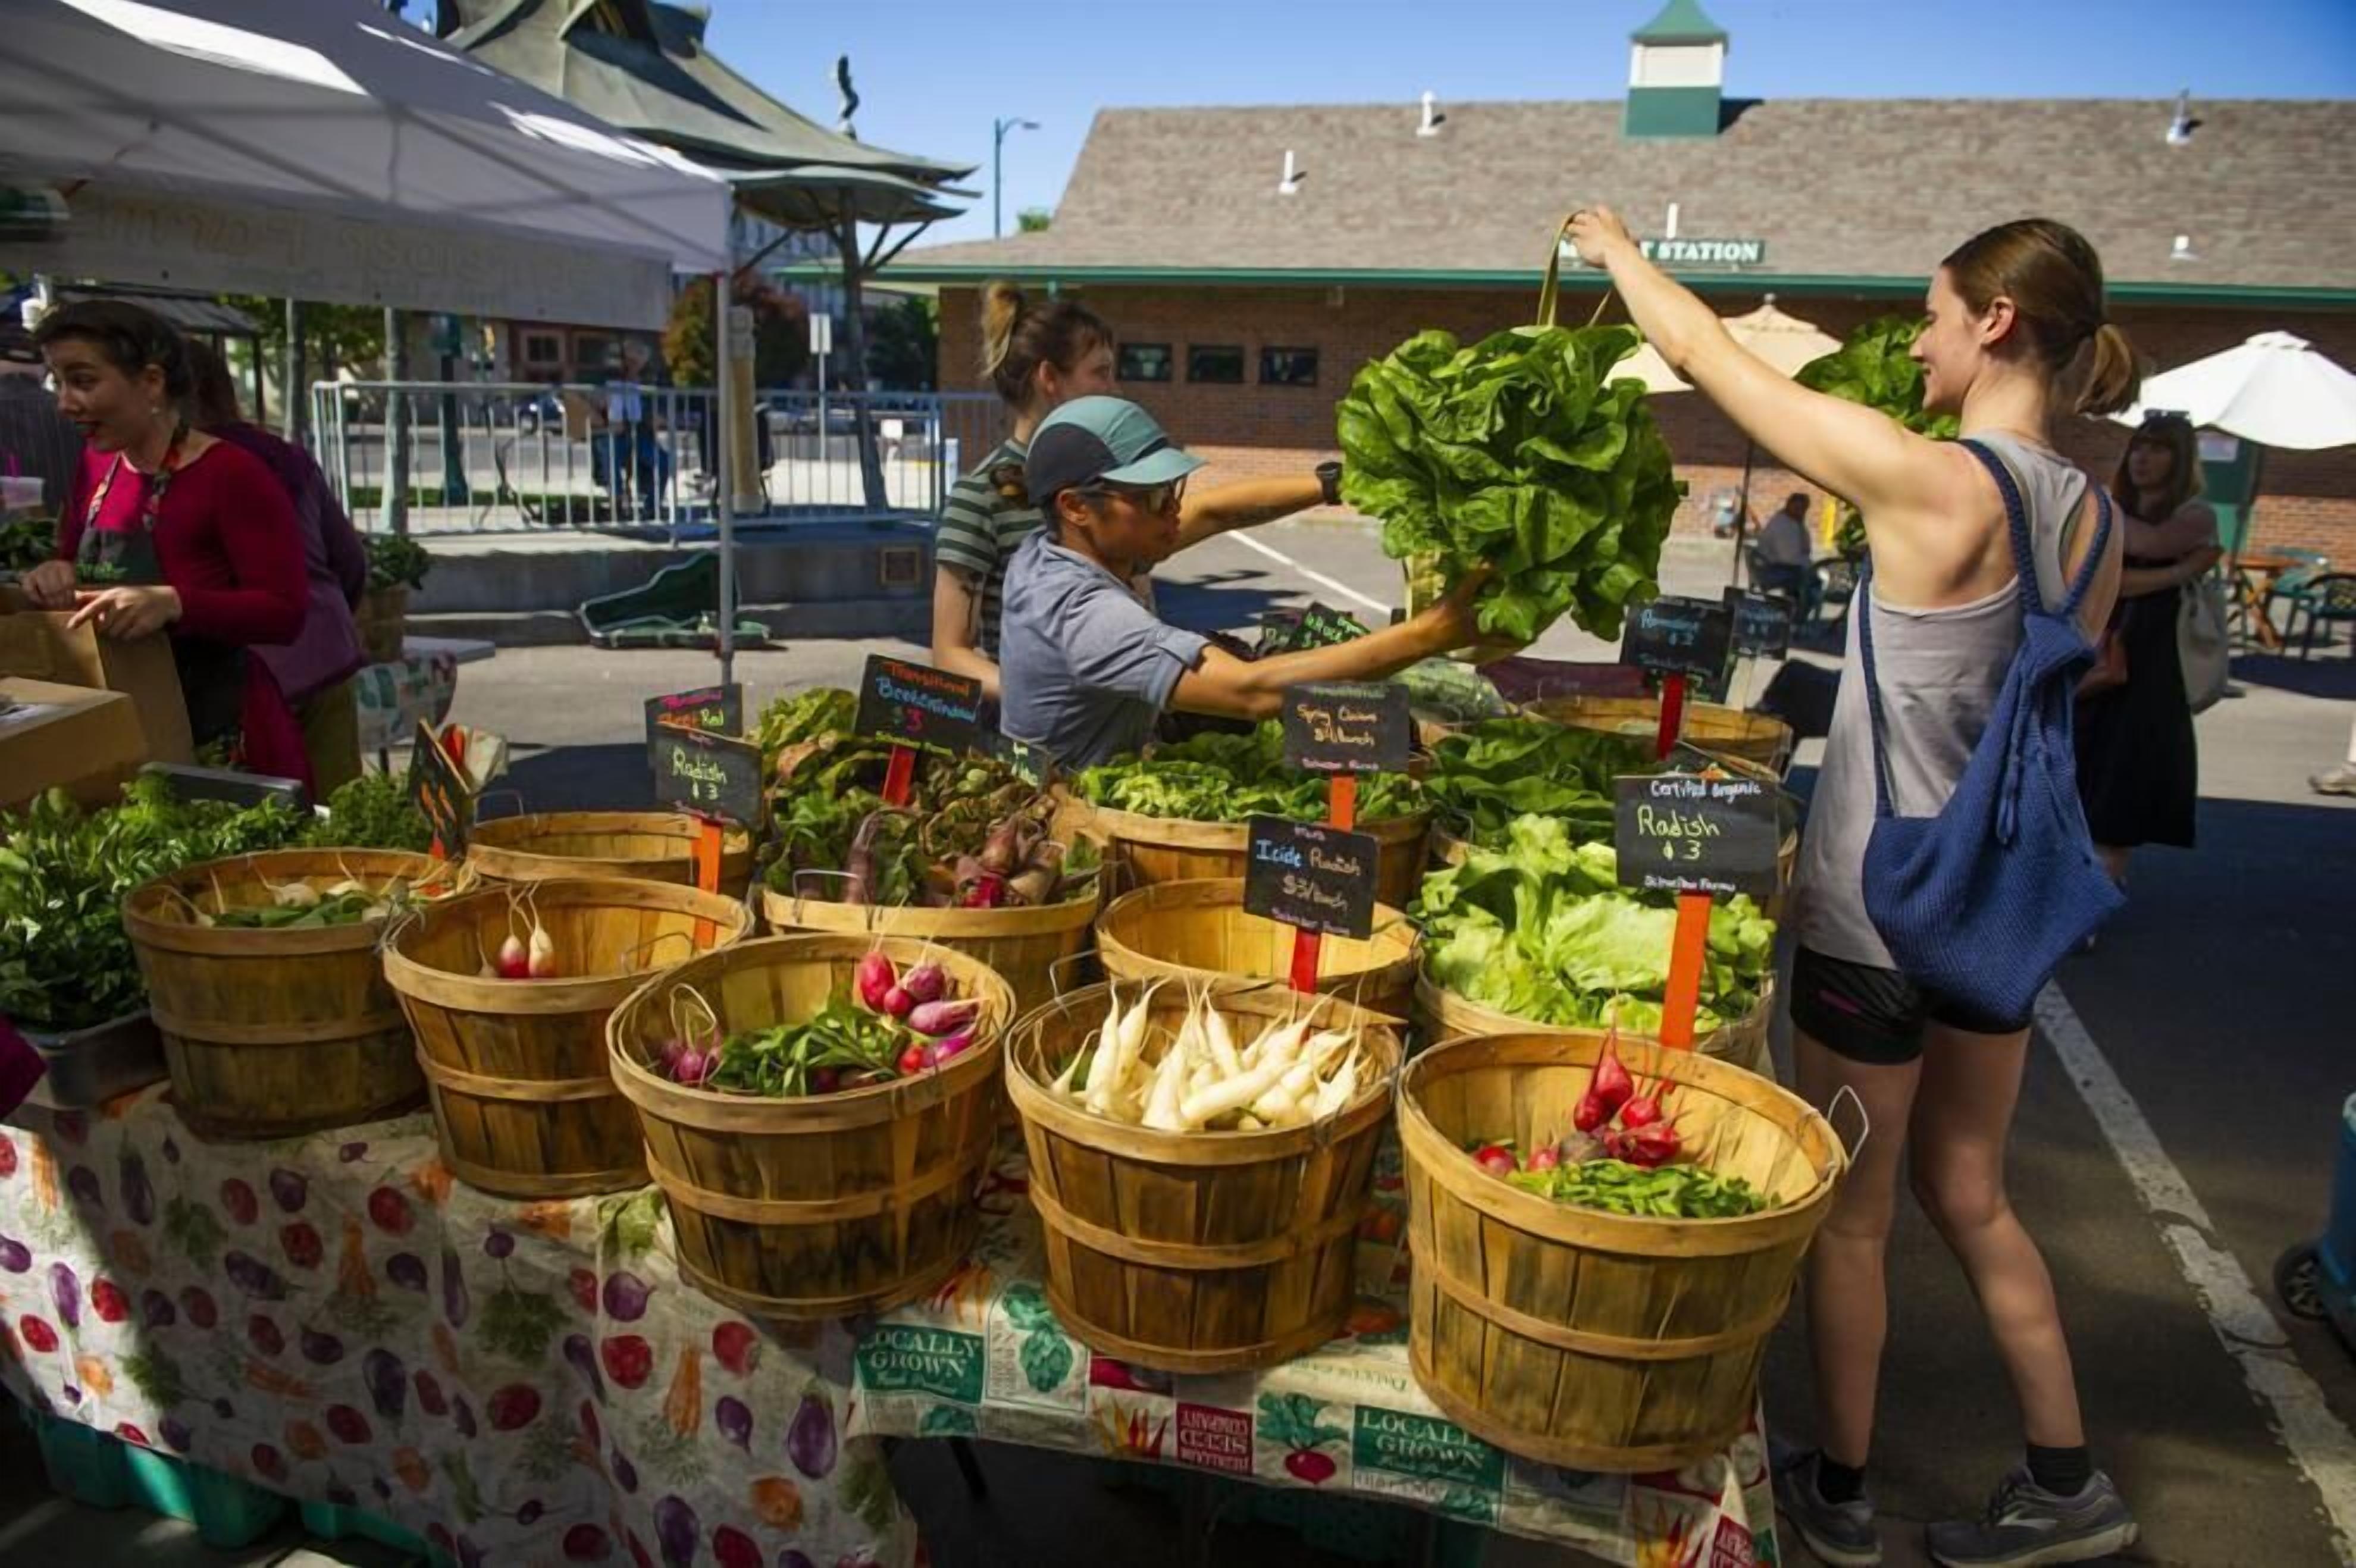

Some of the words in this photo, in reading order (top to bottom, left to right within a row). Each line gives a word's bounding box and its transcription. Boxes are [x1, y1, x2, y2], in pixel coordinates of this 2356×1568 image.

[1658, 240, 1759, 261] STATION
[1637, 804, 1720, 838] Radish
[870, 1351, 967, 1378] GROWN
[1376, 1434, 1485, 1469] GROWN
